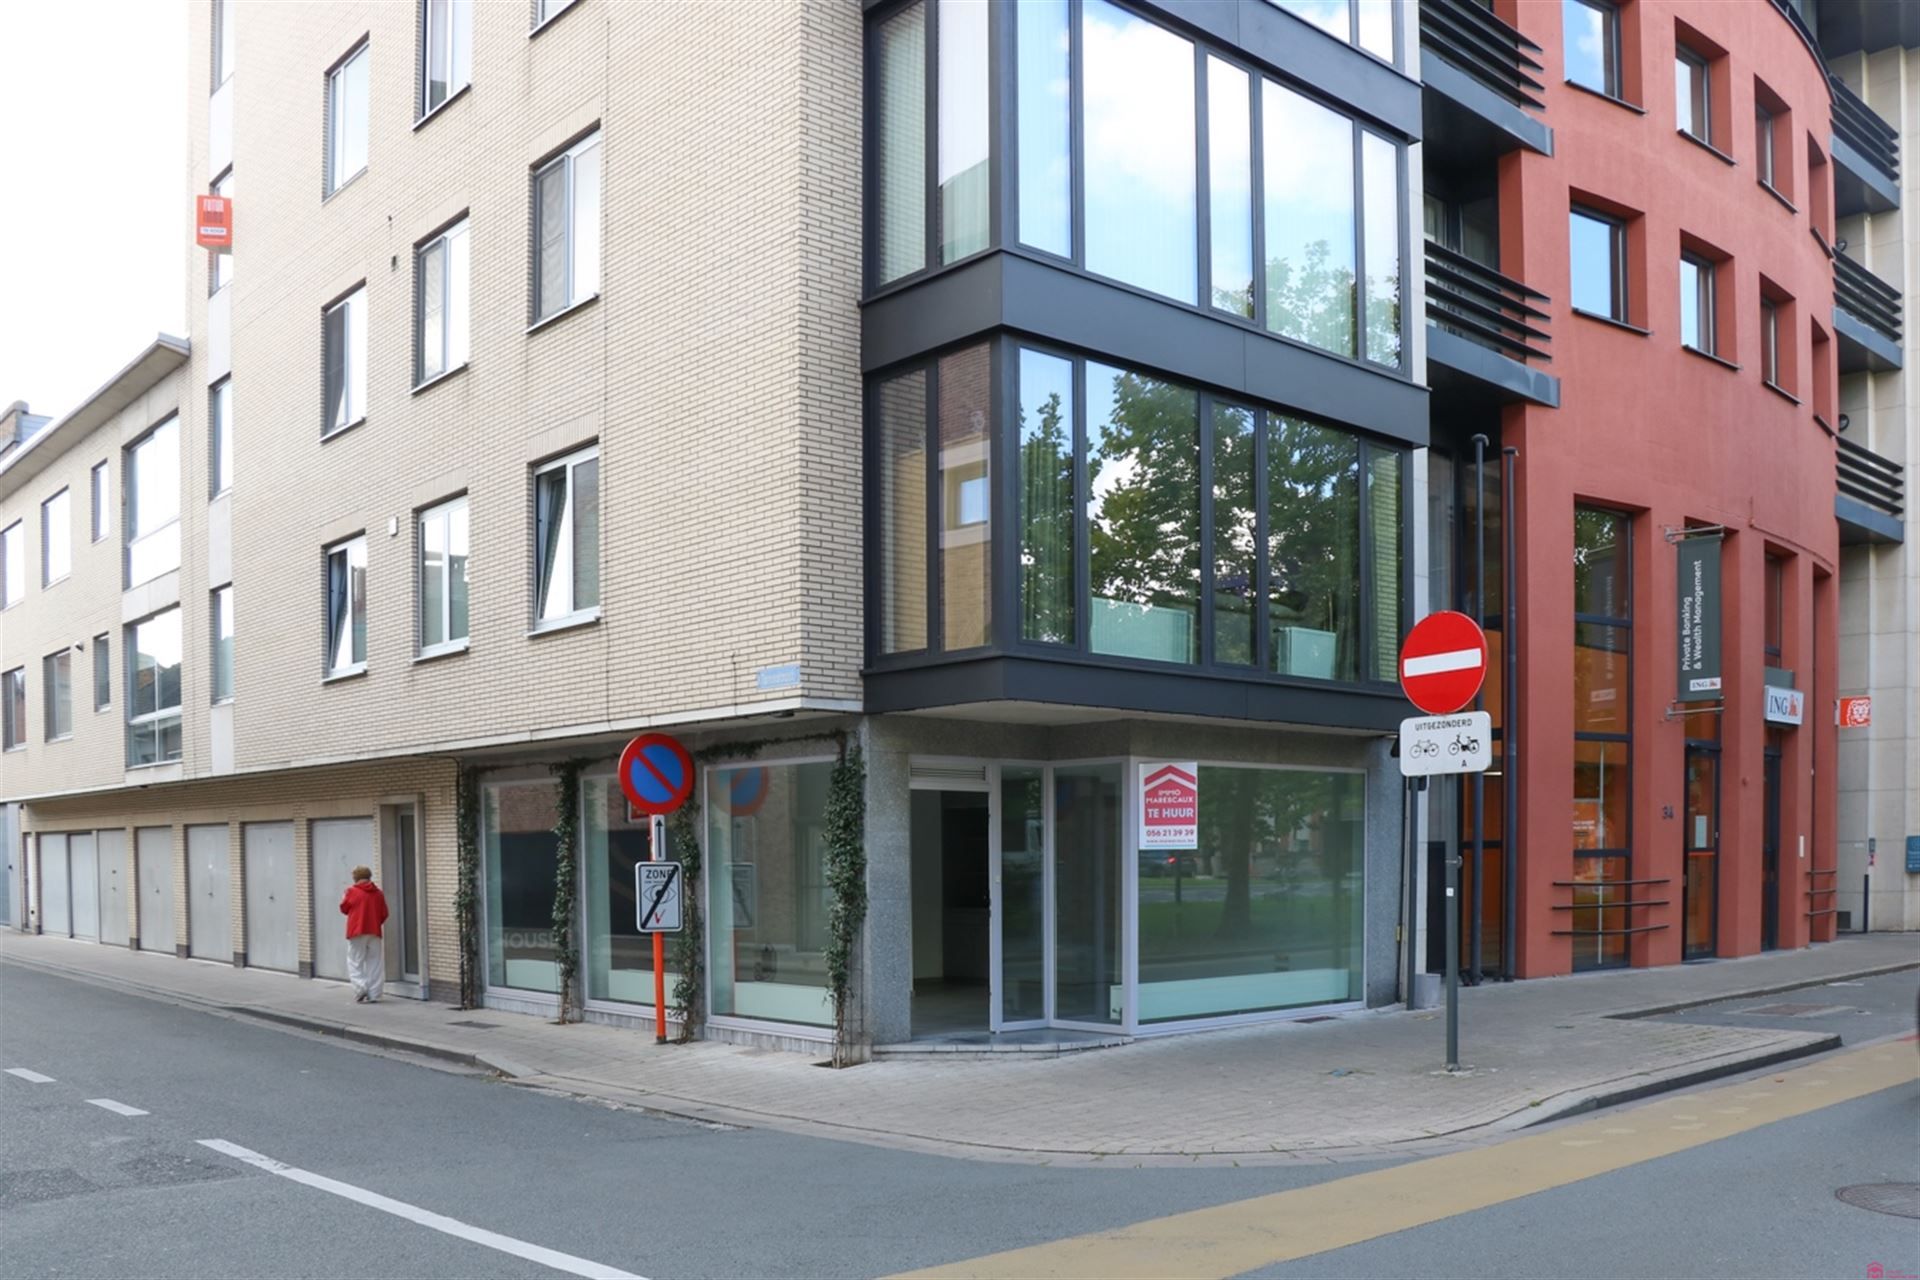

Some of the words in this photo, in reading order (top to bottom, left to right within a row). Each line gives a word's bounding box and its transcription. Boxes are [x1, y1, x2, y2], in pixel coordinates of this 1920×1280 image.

[1693, 560, 1704, 623] Management
[1682, 597, 1692, 636] Banking
[1693, 625, 1702, 660] Wealth
[1682, 637, 1691, 671] Private
[1693, 662, 1702, 670] &
[1692, 680, 1708, 689] ING
[1769, 695, 1788, 716] ING
[1414, 718, 1473, 731] UITGEZONDERD
[1461, 759, 1467, 767] A
[1147, 808, 1159, 818] TE
[1162, 807, 1194, 818] HUUR
[1146, 829, 1161, 837] 056
[1163, 828, 1172, 837] 21
[1173, 828, 1183, 837] 39
[1184, 827, 1194, 836] 39
